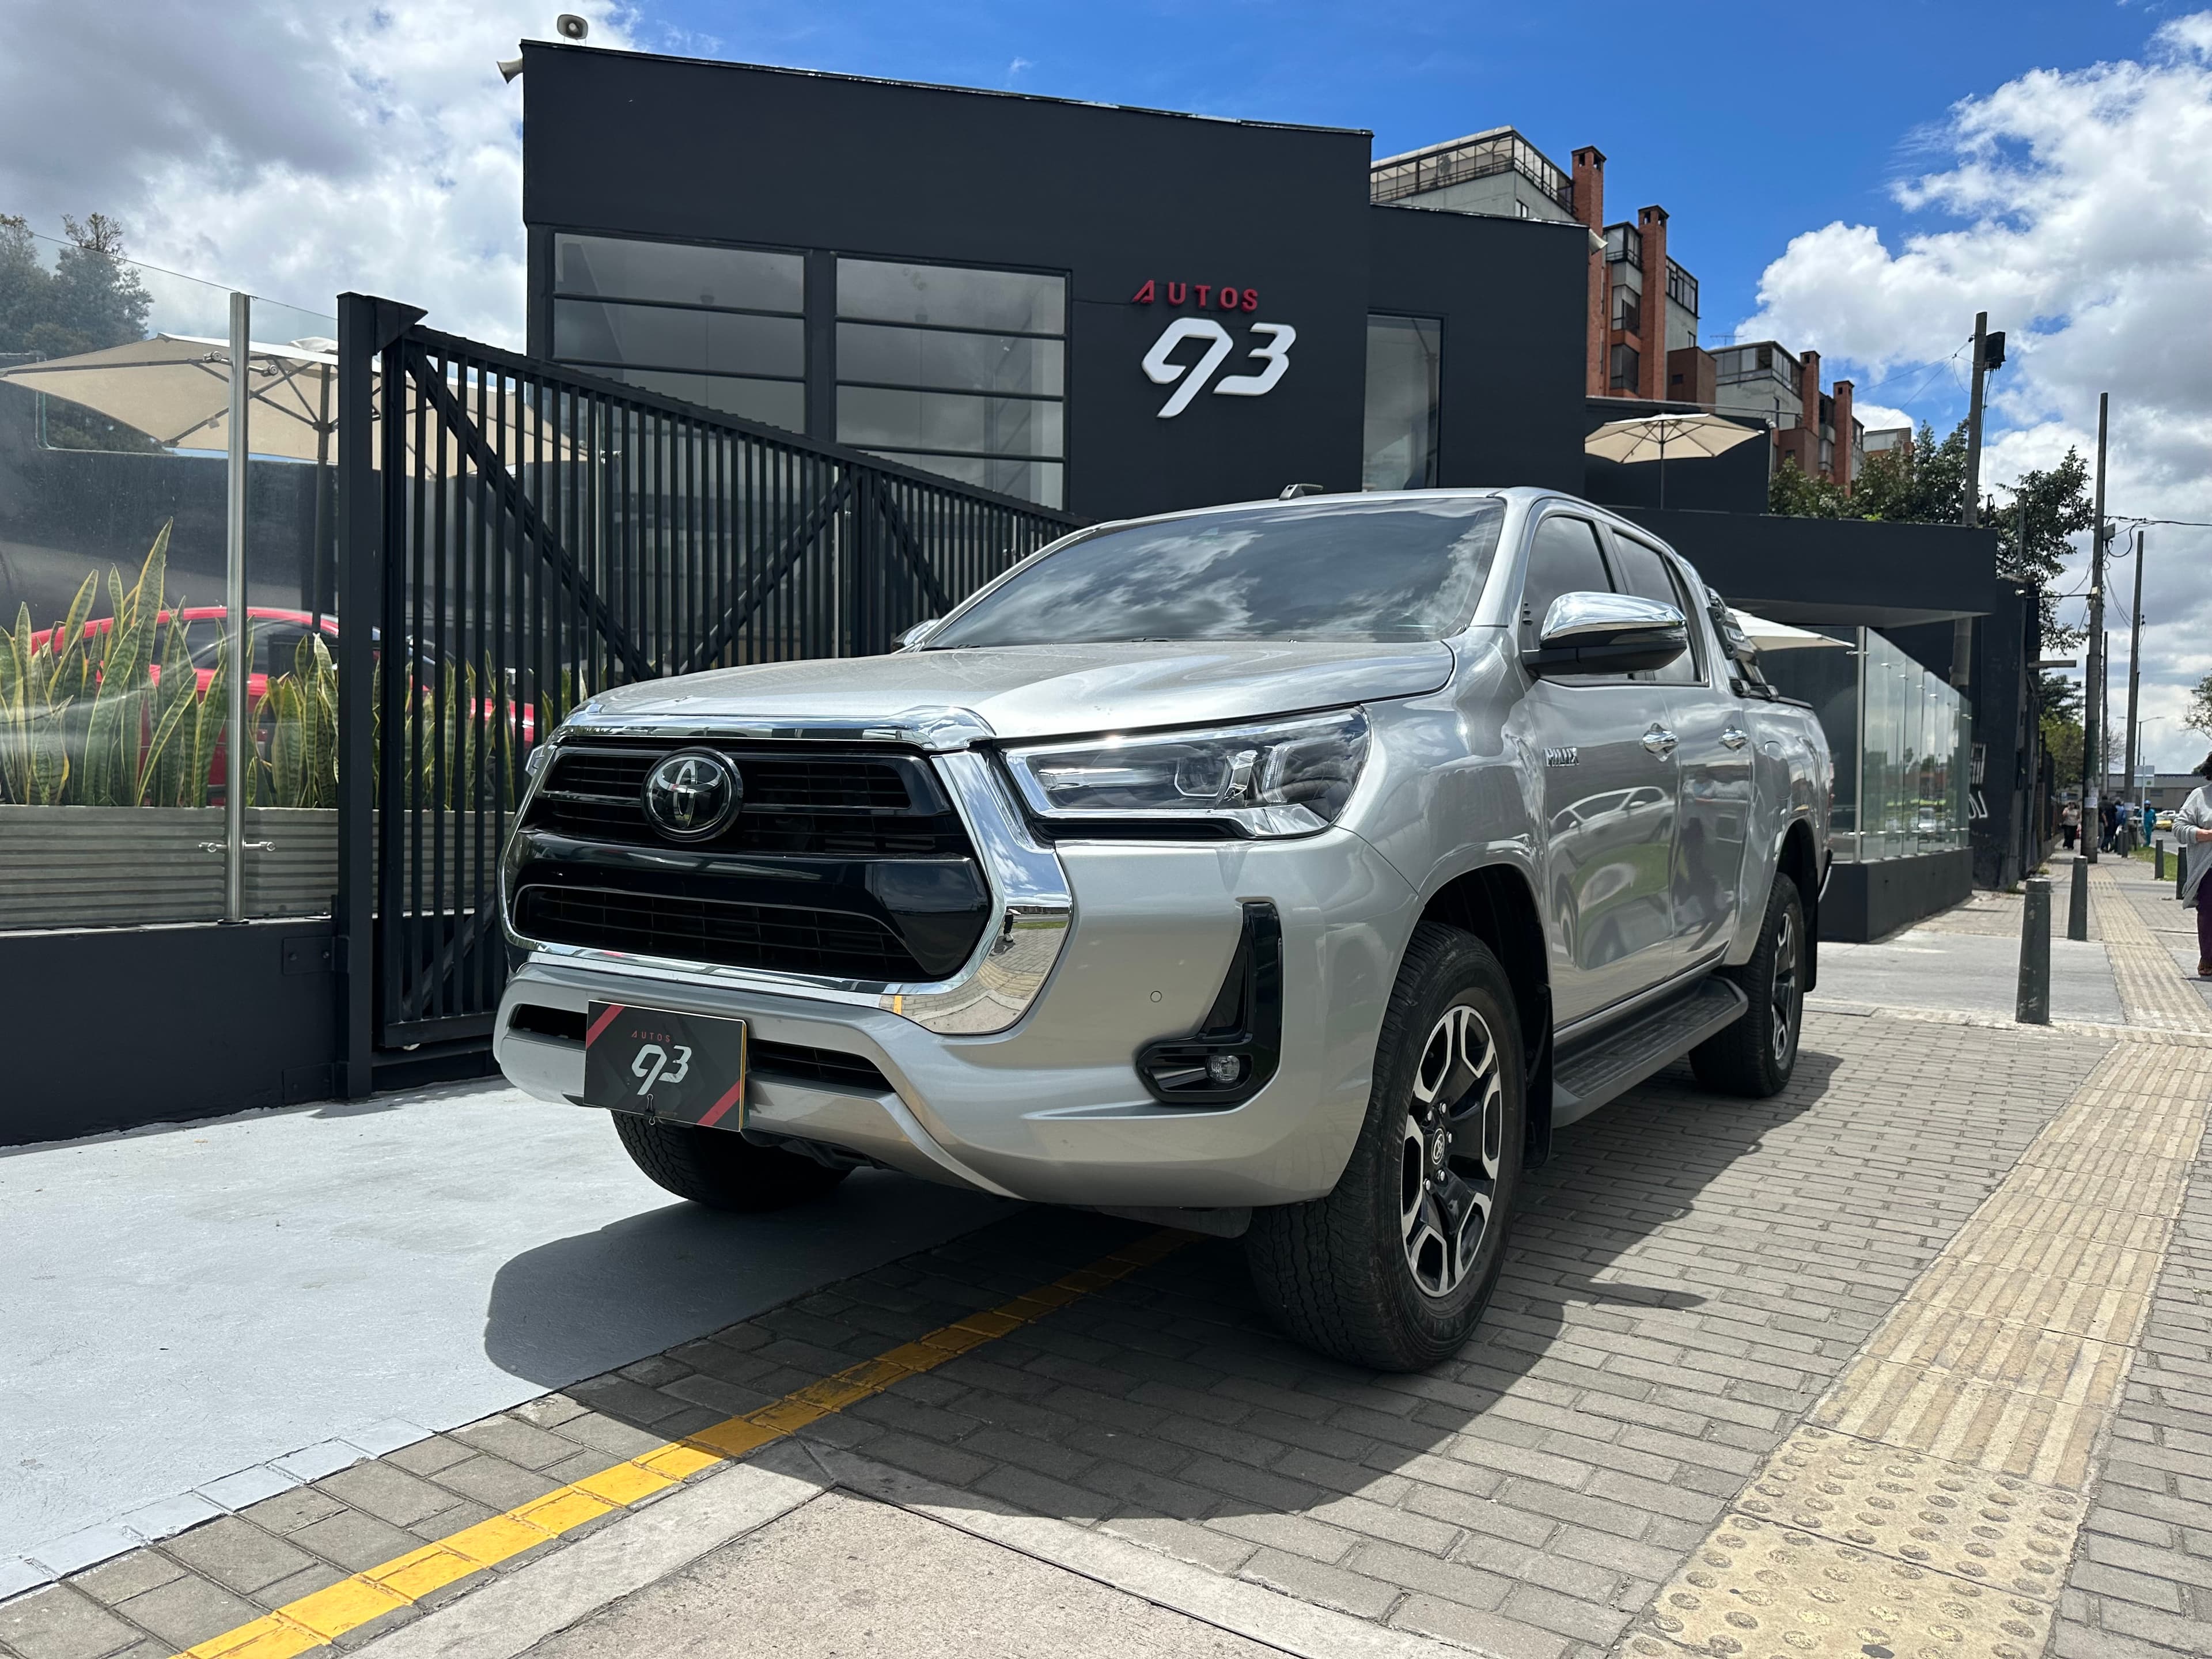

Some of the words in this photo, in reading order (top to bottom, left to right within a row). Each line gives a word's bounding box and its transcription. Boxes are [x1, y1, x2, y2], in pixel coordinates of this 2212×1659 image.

[1131, 279, 1259, 312] AUTOS
[1141, 317, 1297, 418] 93
[1543, 747, 1580, 767] HILUX
[631, 1030, 671, 1043] AUTOS
[631, 1043, 692, 1096] 93
